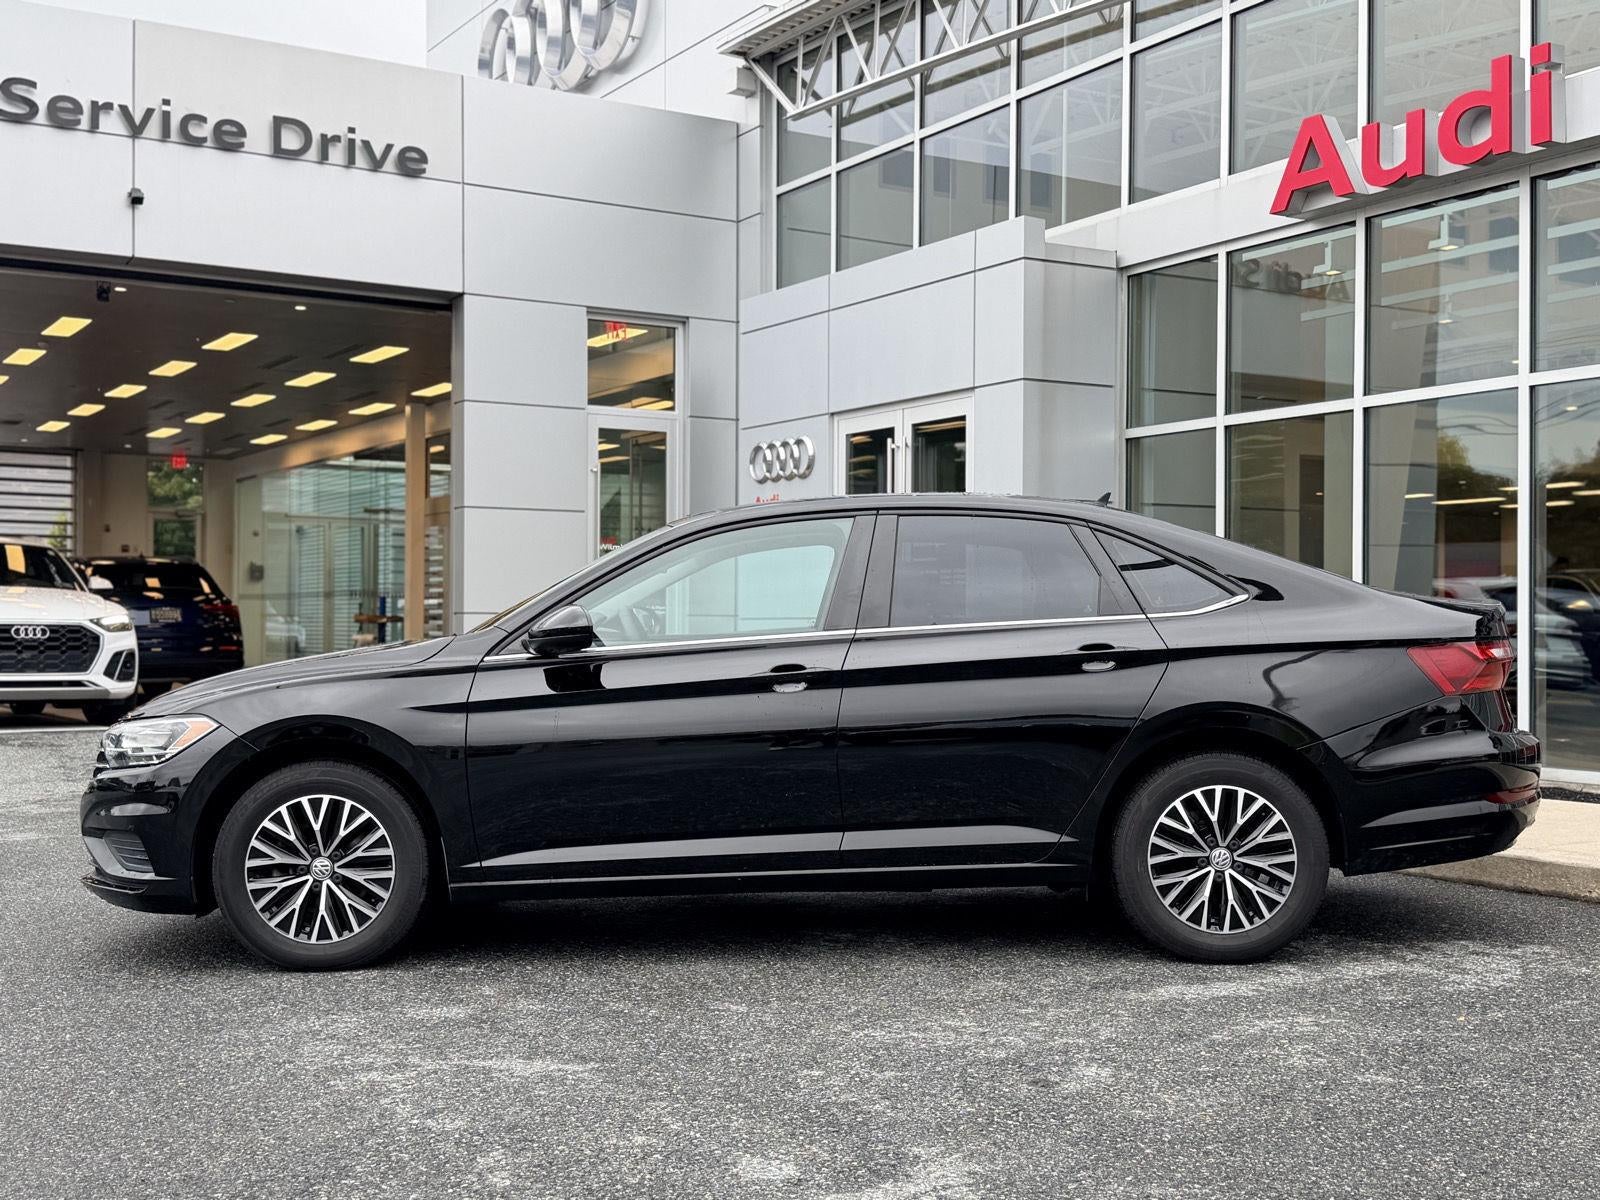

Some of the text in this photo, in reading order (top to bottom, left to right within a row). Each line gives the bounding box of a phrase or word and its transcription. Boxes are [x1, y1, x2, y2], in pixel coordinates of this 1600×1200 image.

[0, 76, 429, 176] Service Drive
[1269, 42, 1560, 215] Audi
